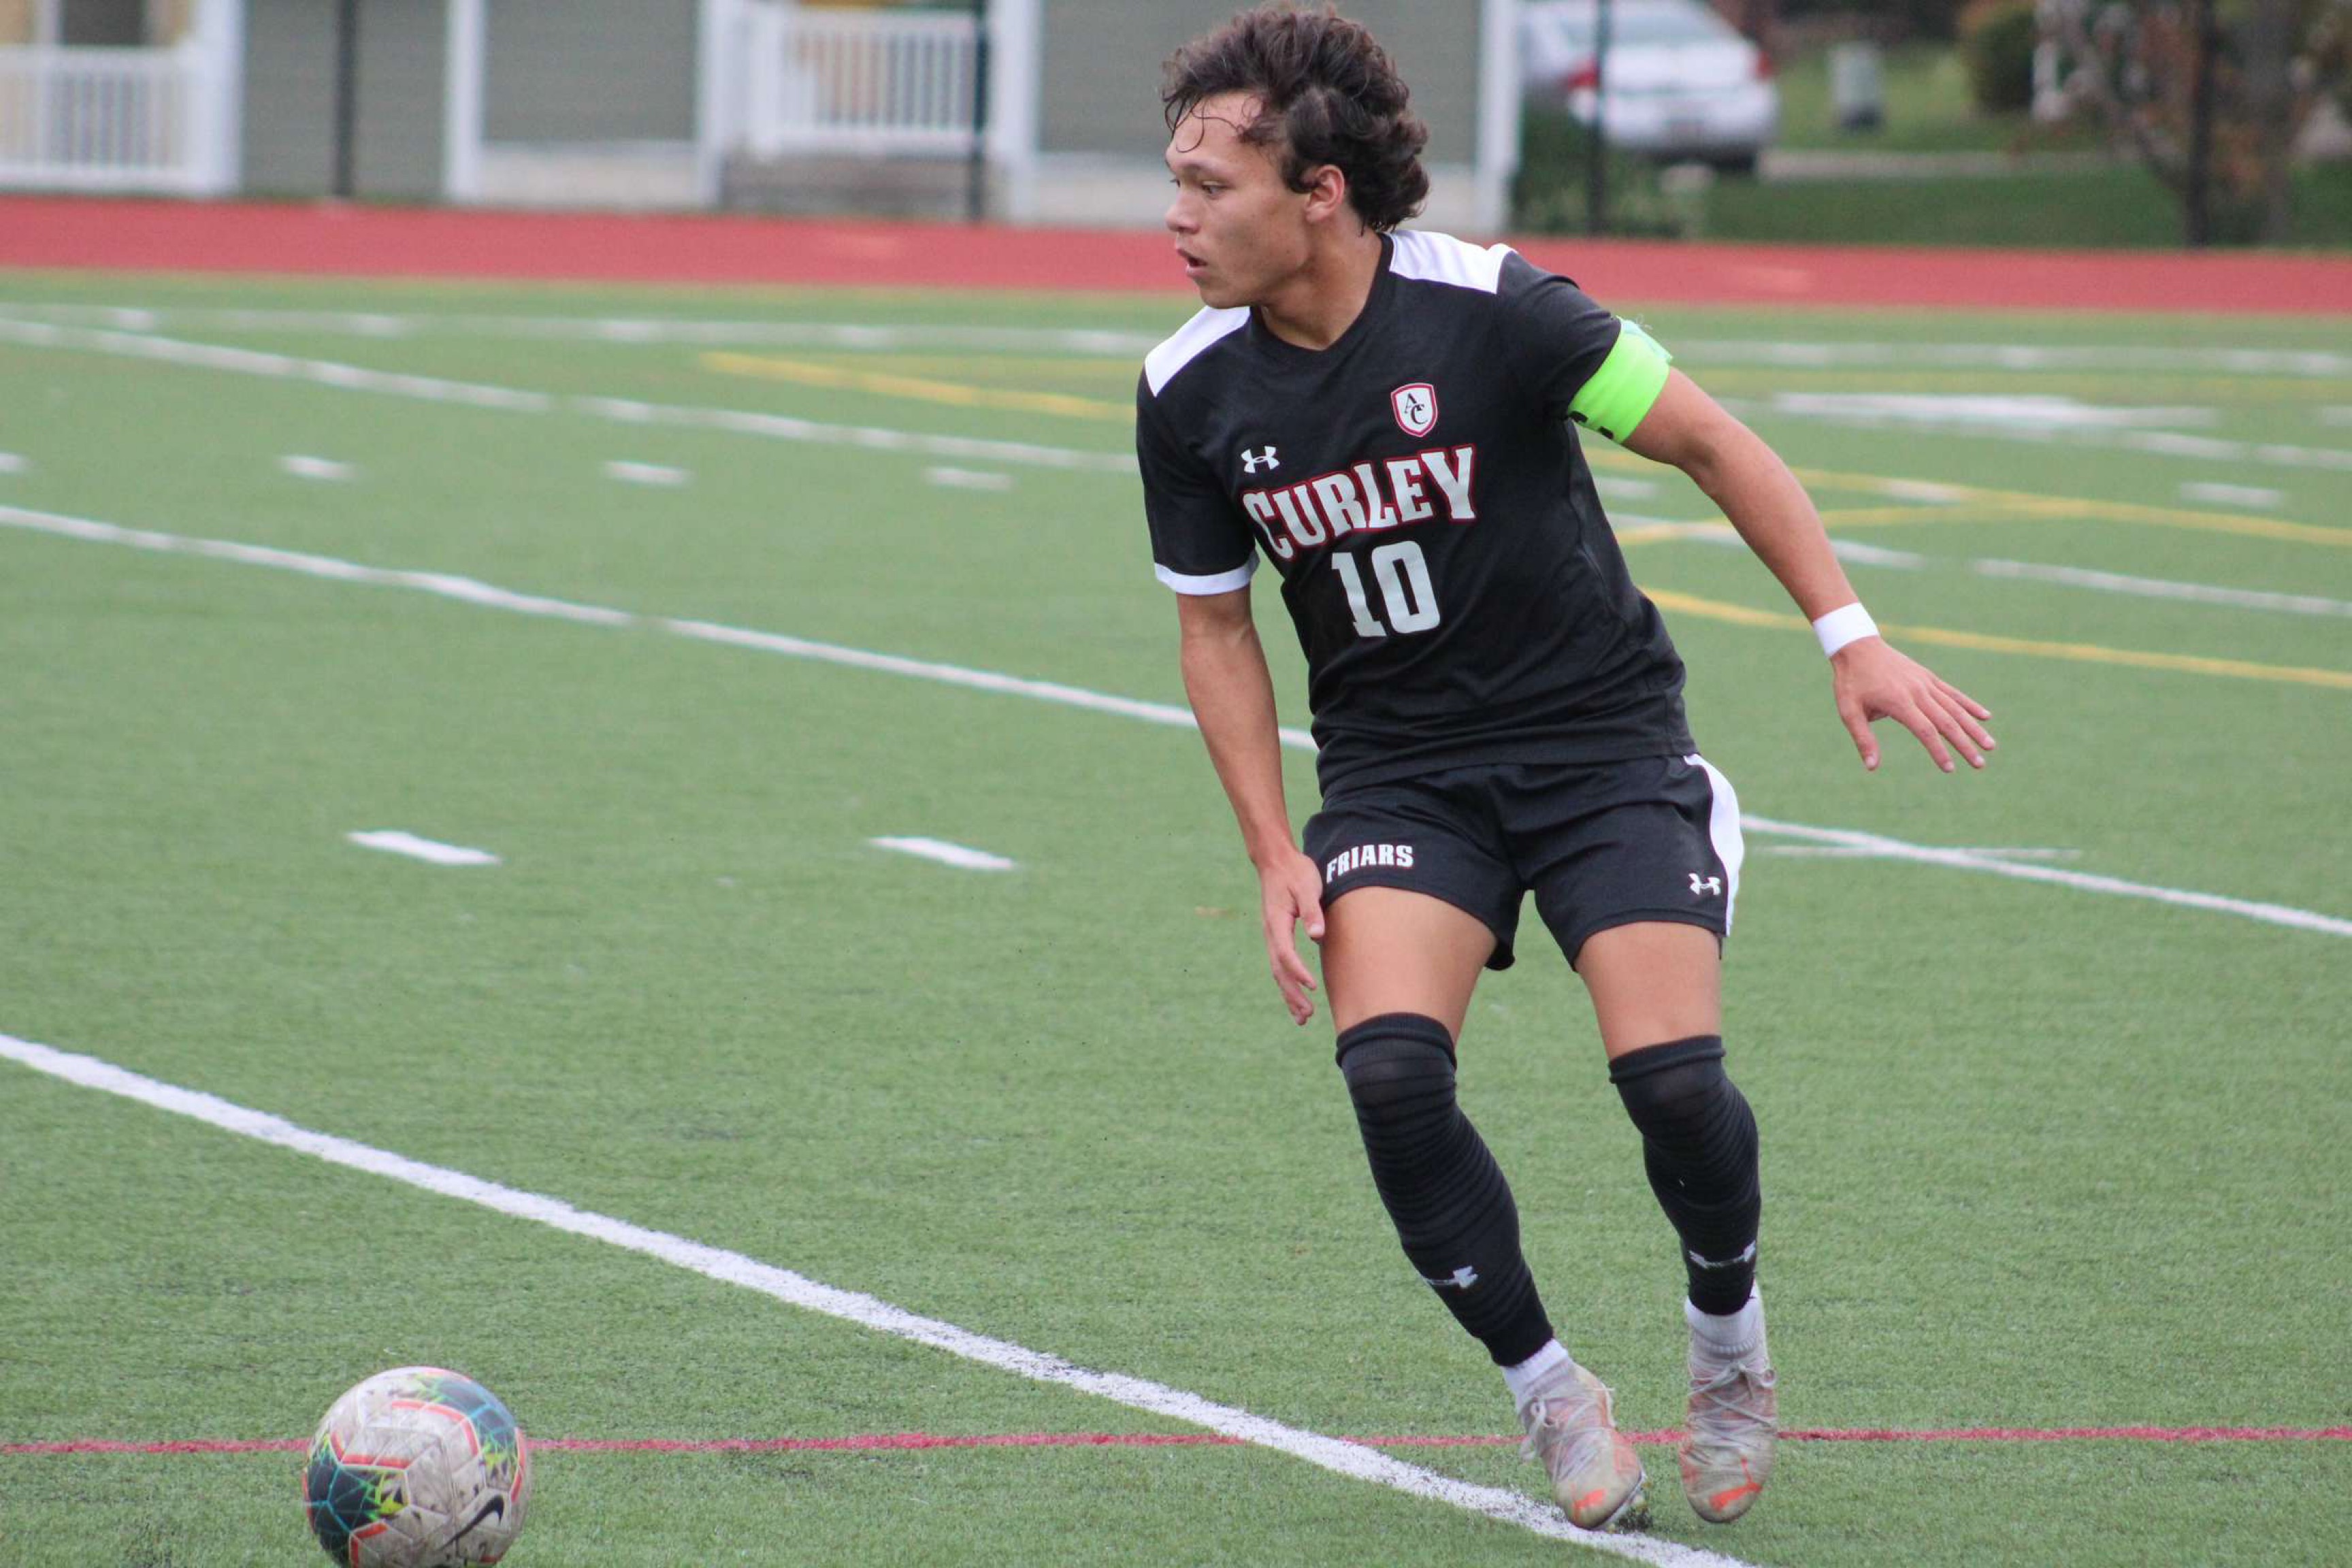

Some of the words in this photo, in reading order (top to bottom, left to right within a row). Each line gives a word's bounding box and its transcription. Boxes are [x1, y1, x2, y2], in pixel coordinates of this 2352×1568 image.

[1241, 445, 1477, 559] CURLEY
[1331, 540, 1441, 638] 10
[1326, 844, 1415, 884] FRIARS
